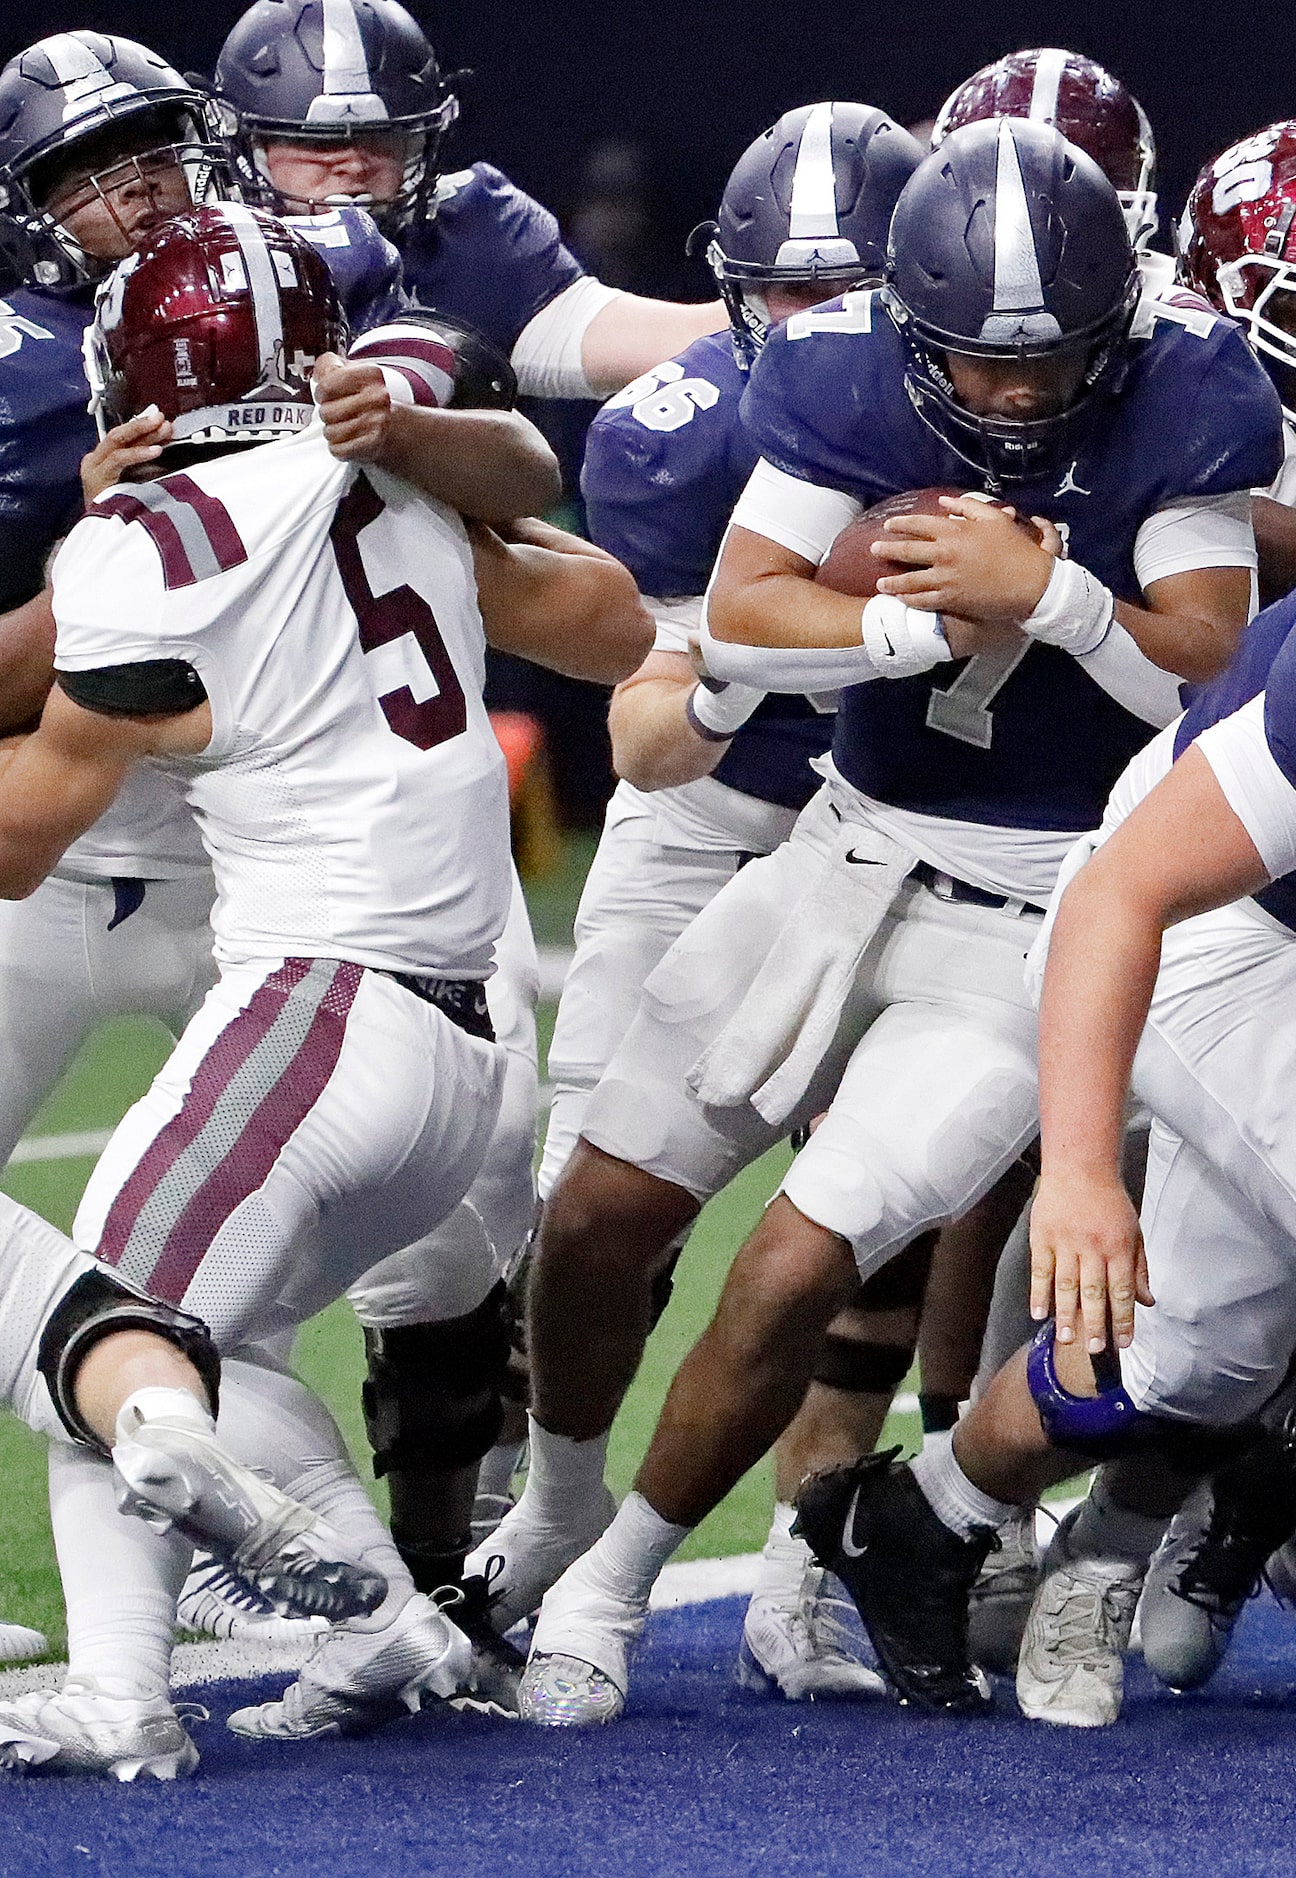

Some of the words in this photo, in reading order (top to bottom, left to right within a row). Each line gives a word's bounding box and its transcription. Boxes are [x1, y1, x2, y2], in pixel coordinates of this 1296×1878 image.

[786, 290, 873, 341] 7
[228, 409, 265, 427] RED
[272, 407, 305, 425] OAK
[329, 468, 467, 751] 5
